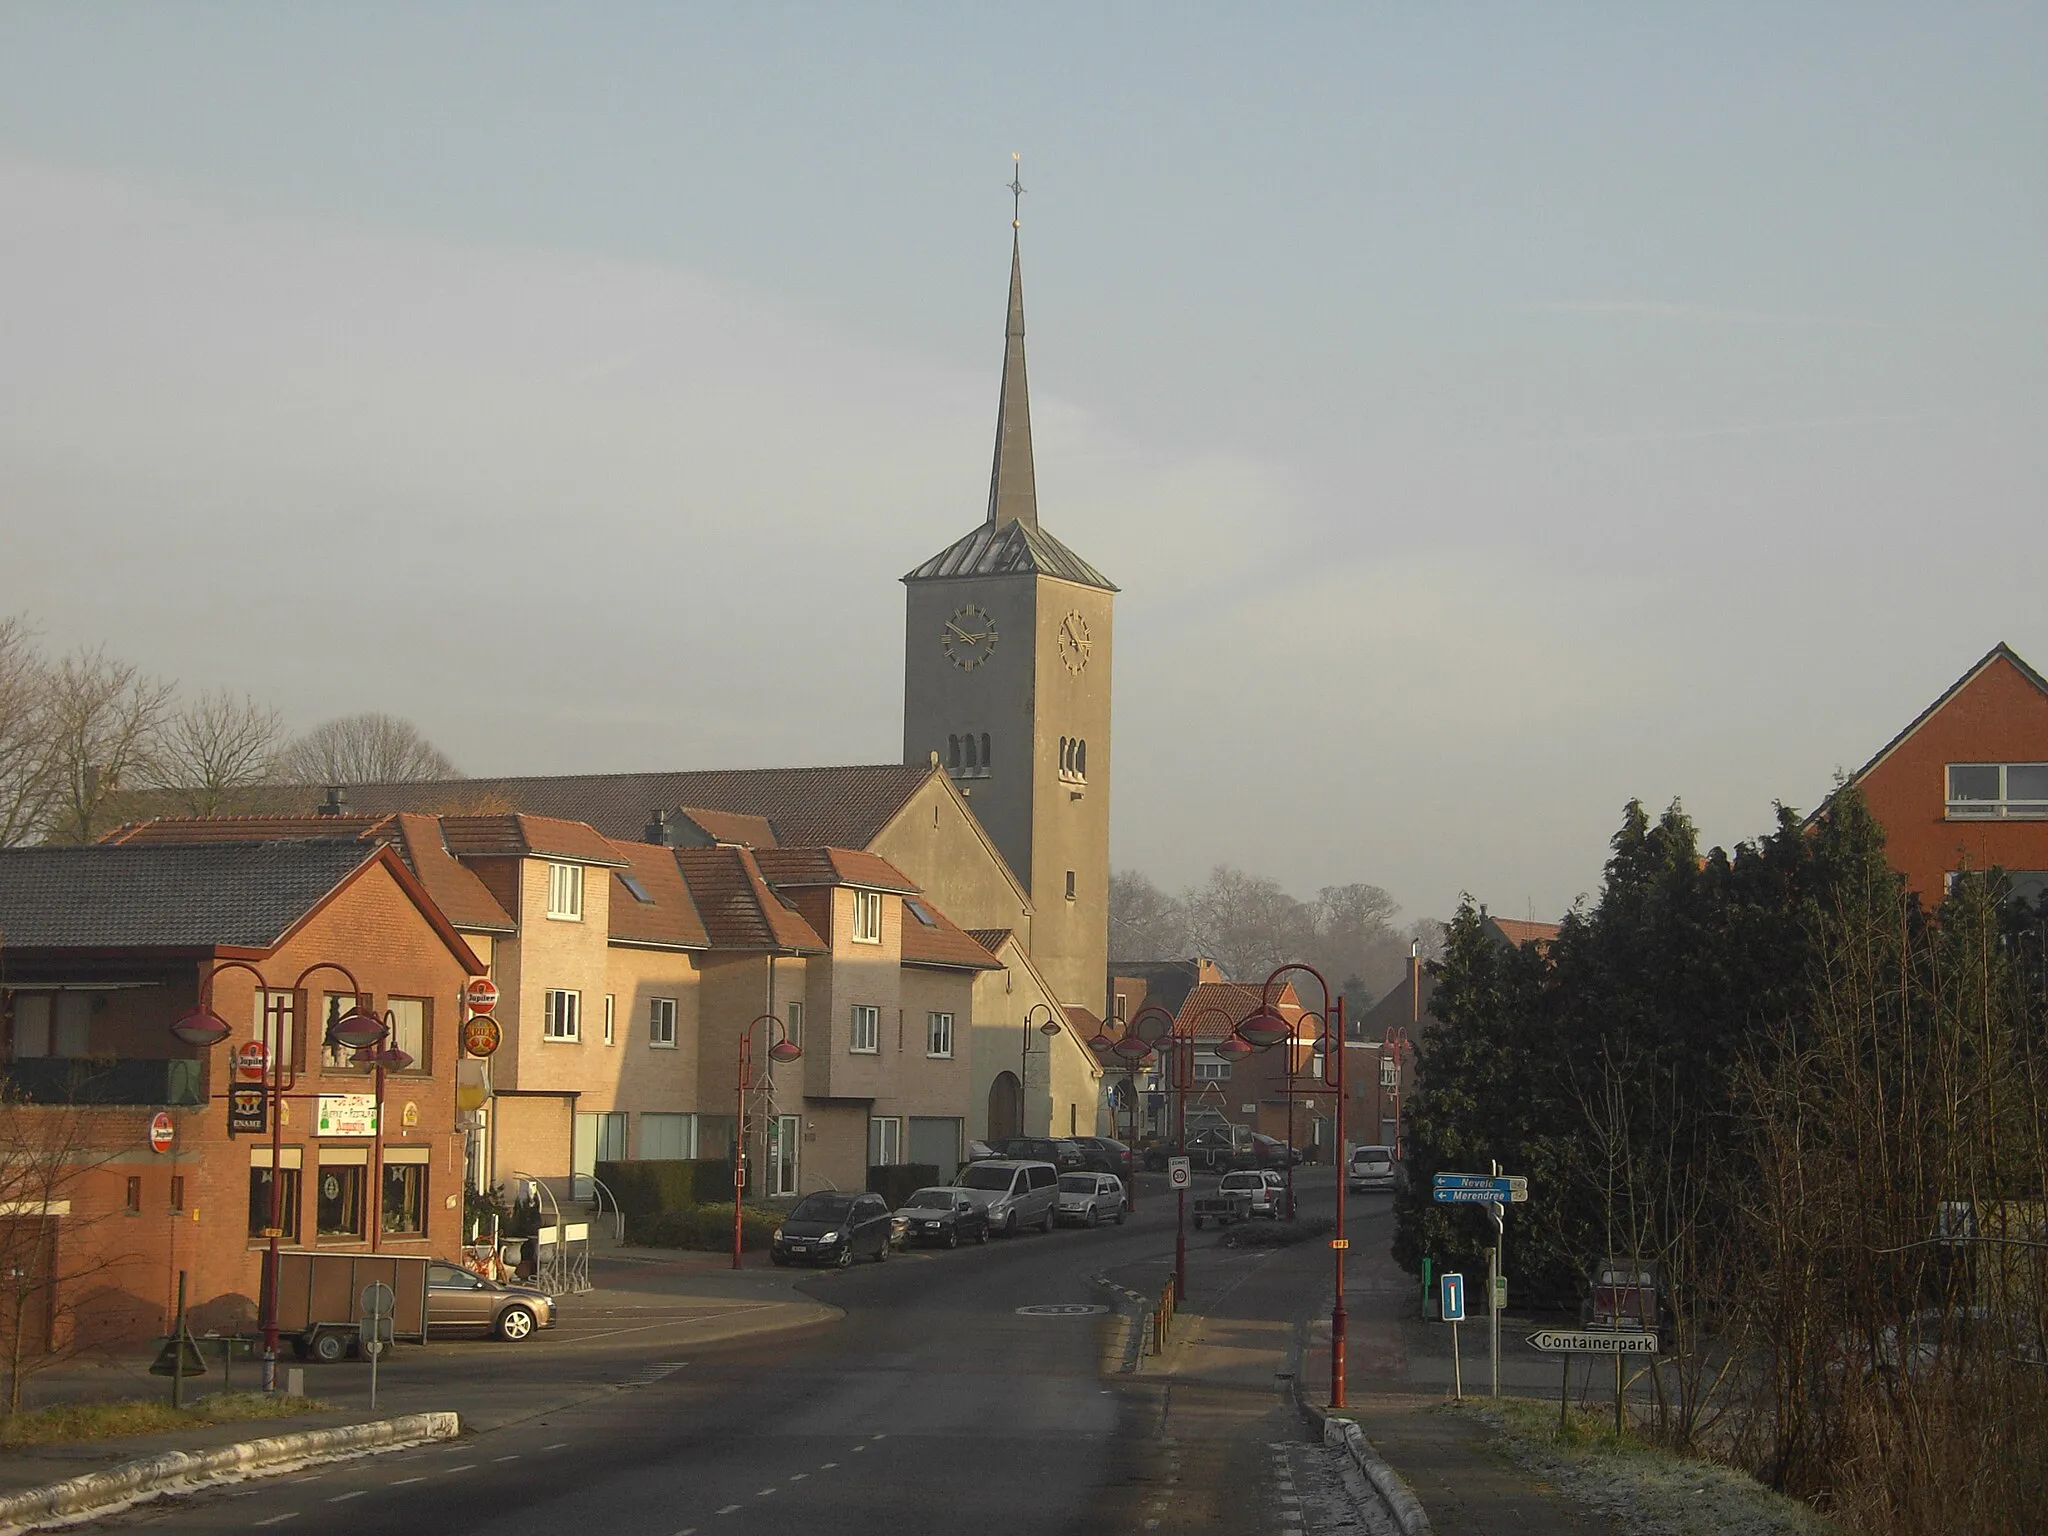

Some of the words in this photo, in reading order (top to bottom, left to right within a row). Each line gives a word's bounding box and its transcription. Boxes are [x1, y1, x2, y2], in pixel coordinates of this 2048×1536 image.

[469, 993, 496, 1002] Jupiler
[240, 1057, 265, 1066] Jupile
[233, 1119, 262, 1128] ENAME
[1461, 1178, 1495, 1188] Nevele
[1453, 1191, 1505, 1201] Merendree
[1542, 1334, 1653, 1353] Containerpark
